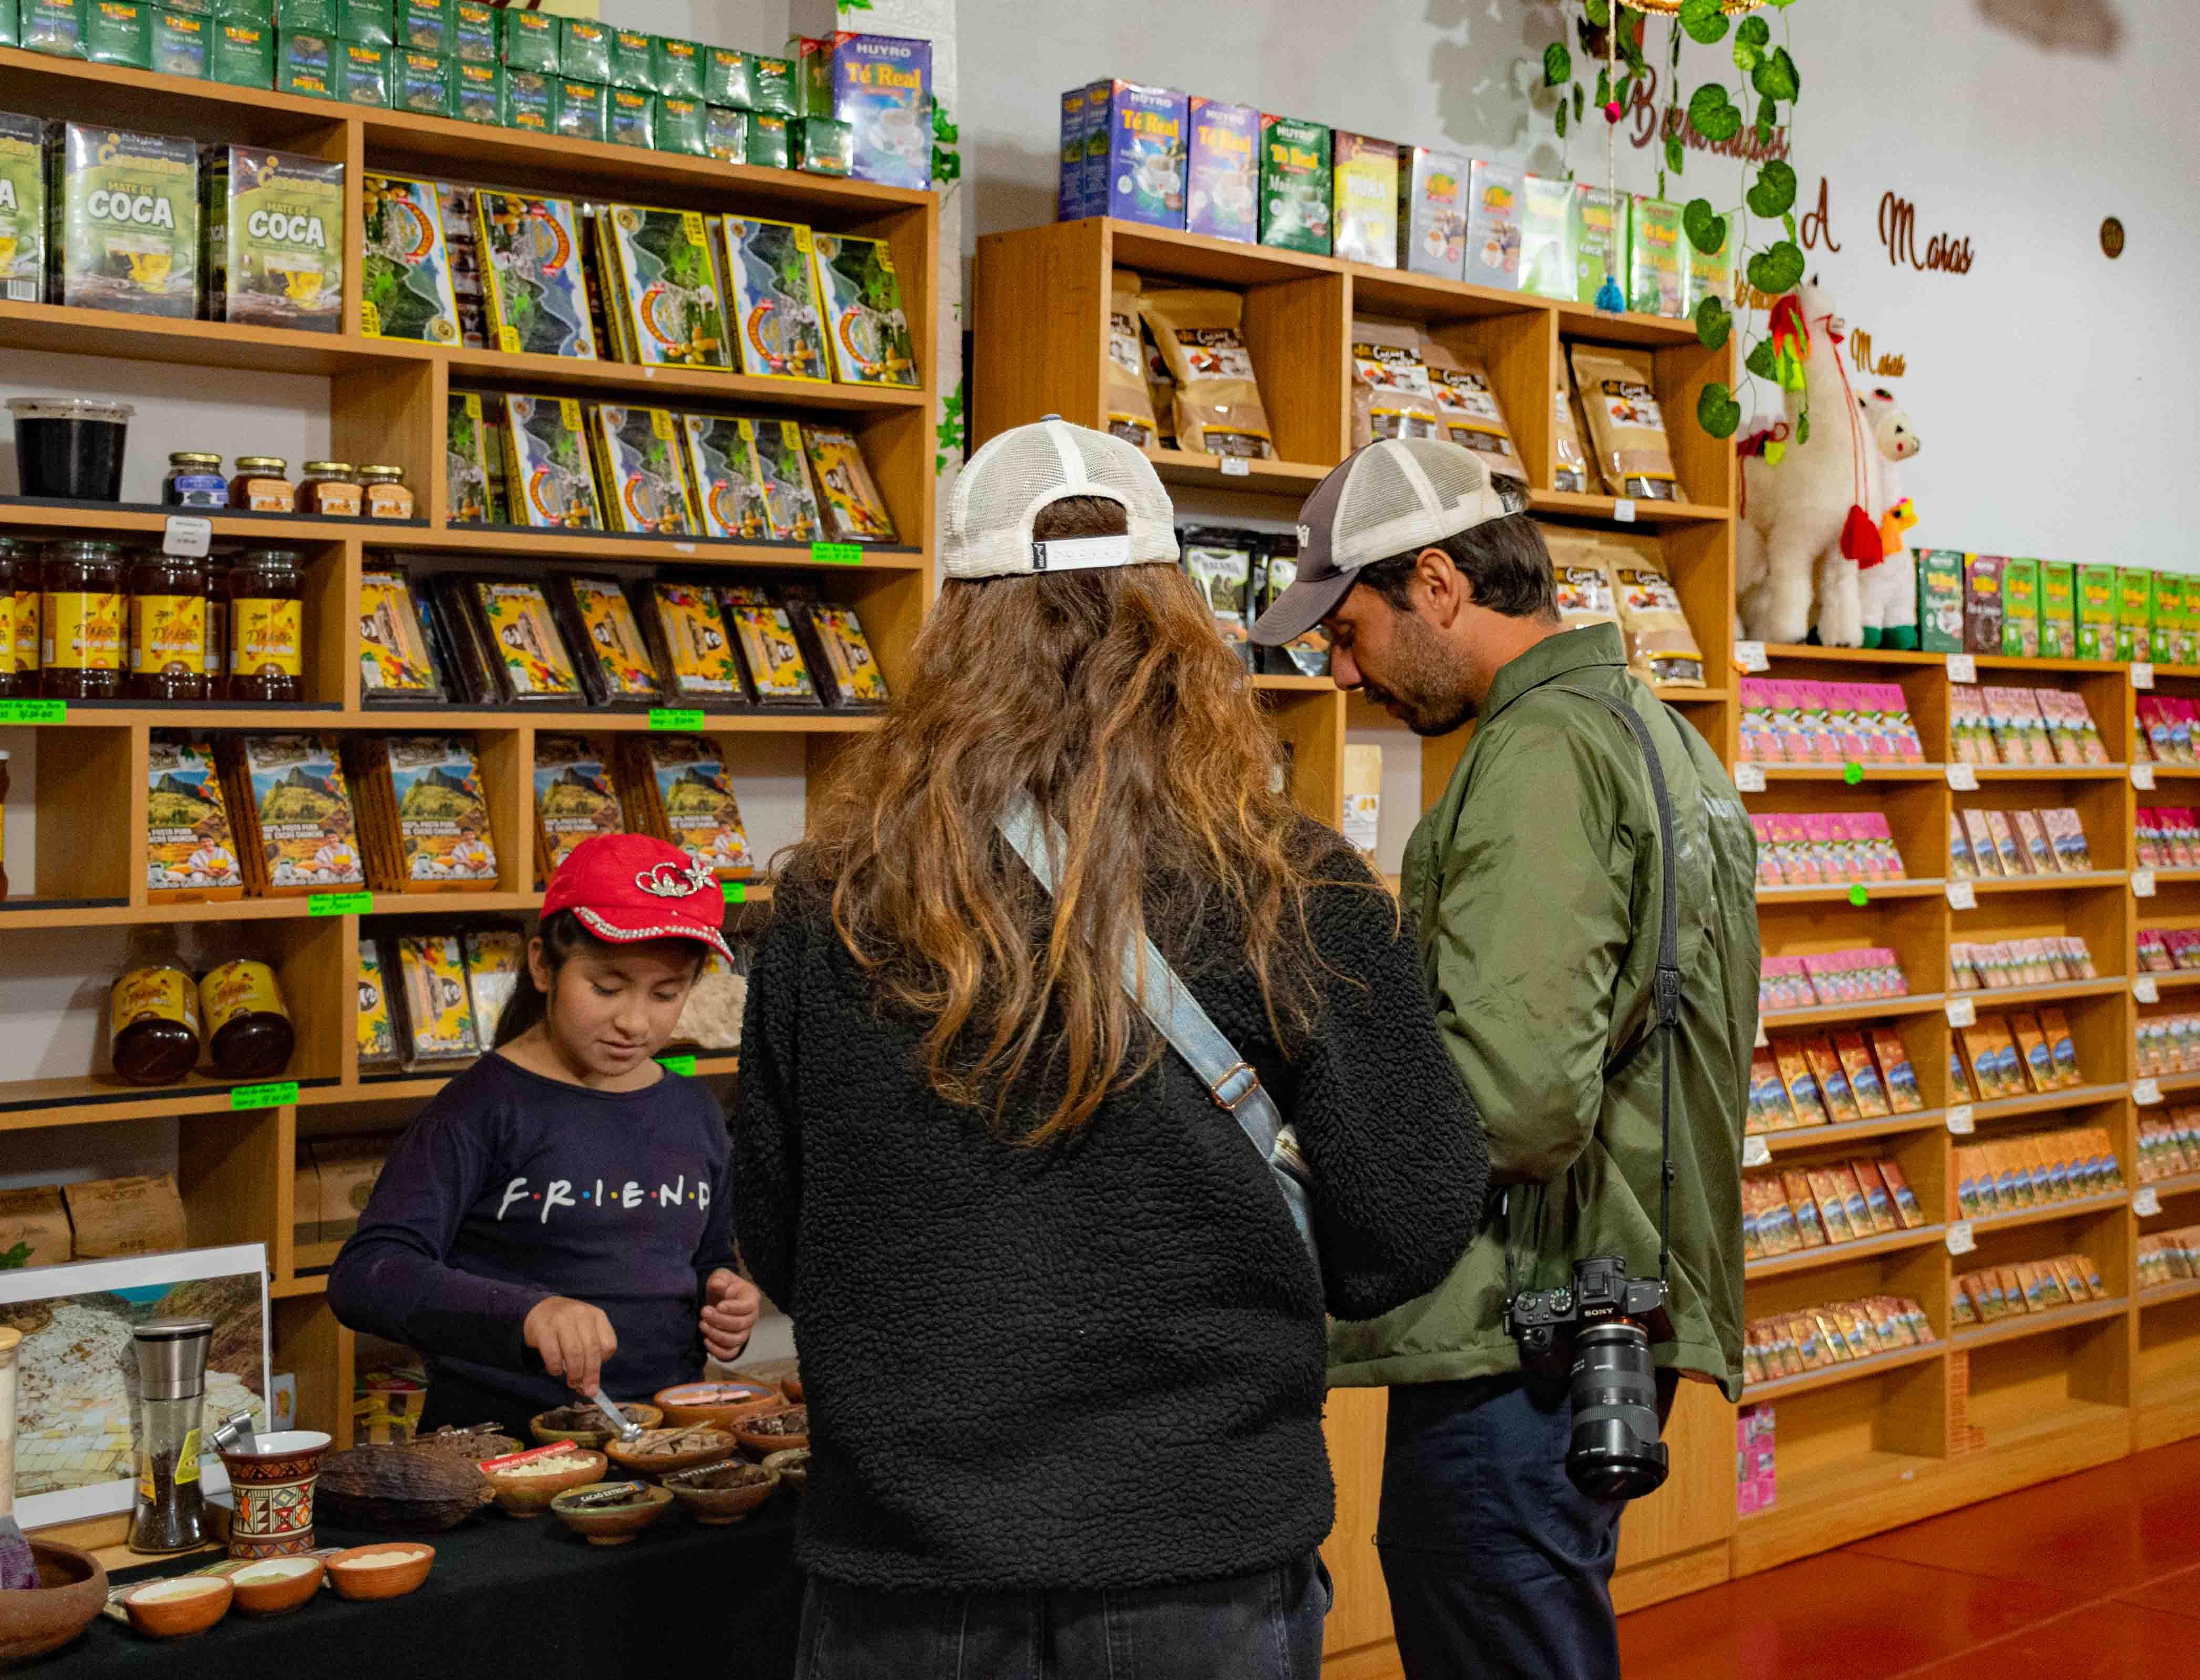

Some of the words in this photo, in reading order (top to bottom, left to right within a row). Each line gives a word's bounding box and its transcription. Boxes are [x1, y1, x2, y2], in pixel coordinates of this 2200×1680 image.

[856, 43, 911, 58] HUYRO
[845, 61, 871, 84] Té
[877, 63, 922, 89] Real
[1121, 109, 1143, 131] Té
[1145, 111, 1179, 138] Real
[1222, 127, 1252, 153] Real
[109, 181, 138, 193] MATE
[88, 190, 174, 229] COCA
[1801, 176, 1841, 253] A
[247, 210, 325, 248] COCA
[1584, 1308, 1614, 1317] SONY
